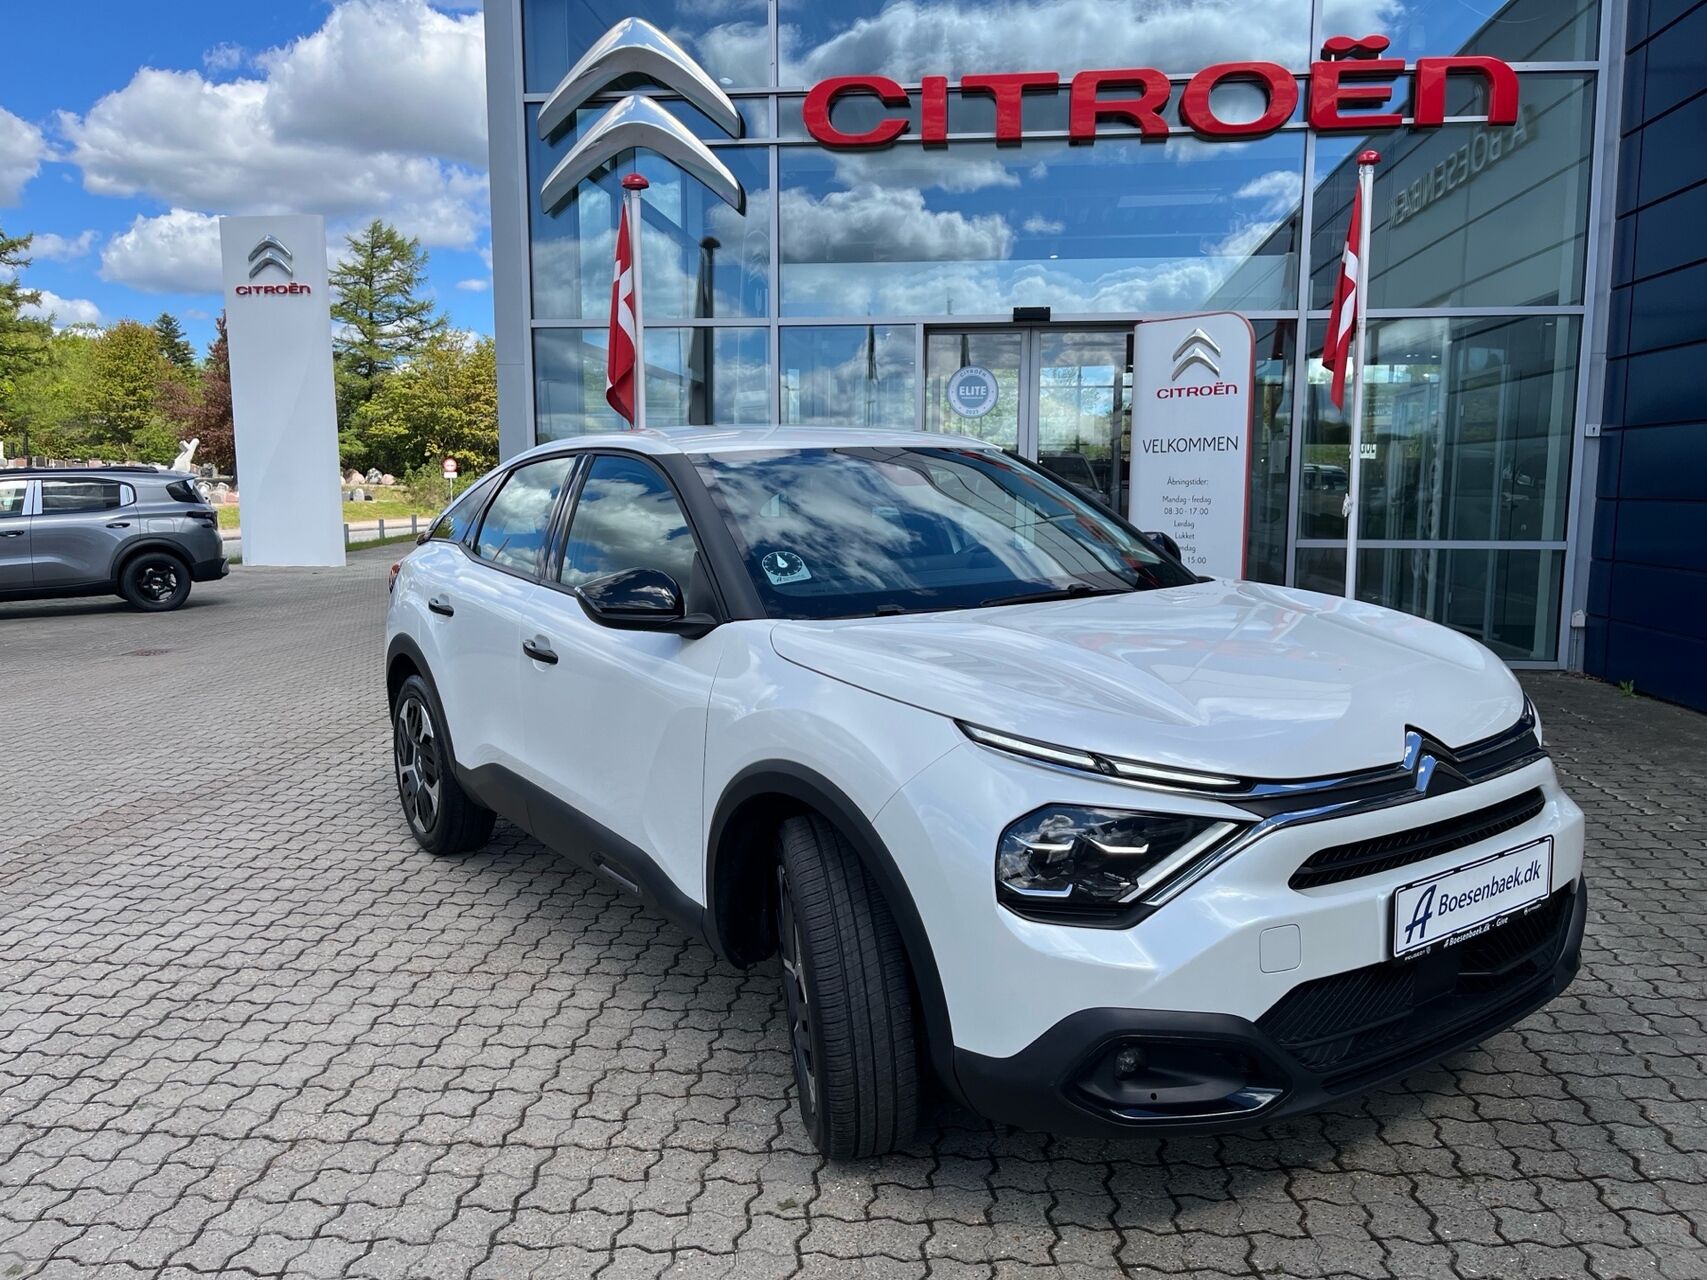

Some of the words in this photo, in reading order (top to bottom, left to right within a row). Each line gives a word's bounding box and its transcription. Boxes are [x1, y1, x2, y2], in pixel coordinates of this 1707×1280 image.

[803, 35, 1520, 149] CITROËN
[235, 282, 311, 296] CITROËN
[959, 385, 987, 396] ELITE
[1156, 382, 1238, 399] CITROËN
[1142, 435, 1239, 454] VELKOMMEN
[1166, 476, 1209, 488] Åbningstider:
[1162, 495, 1187, 505] Mandag
[1173, 520, 1195, 529] Lørdag
[1174, 532, 1195, 540] Lukket
[1179, 543, 1196, 554] ndag
[1438, 859, 1542, 916] Boesenbaek.dk
[1449, 922, 1491, 946] Boesenbaek.dk
[1496, 916, 1509, 927] Give
